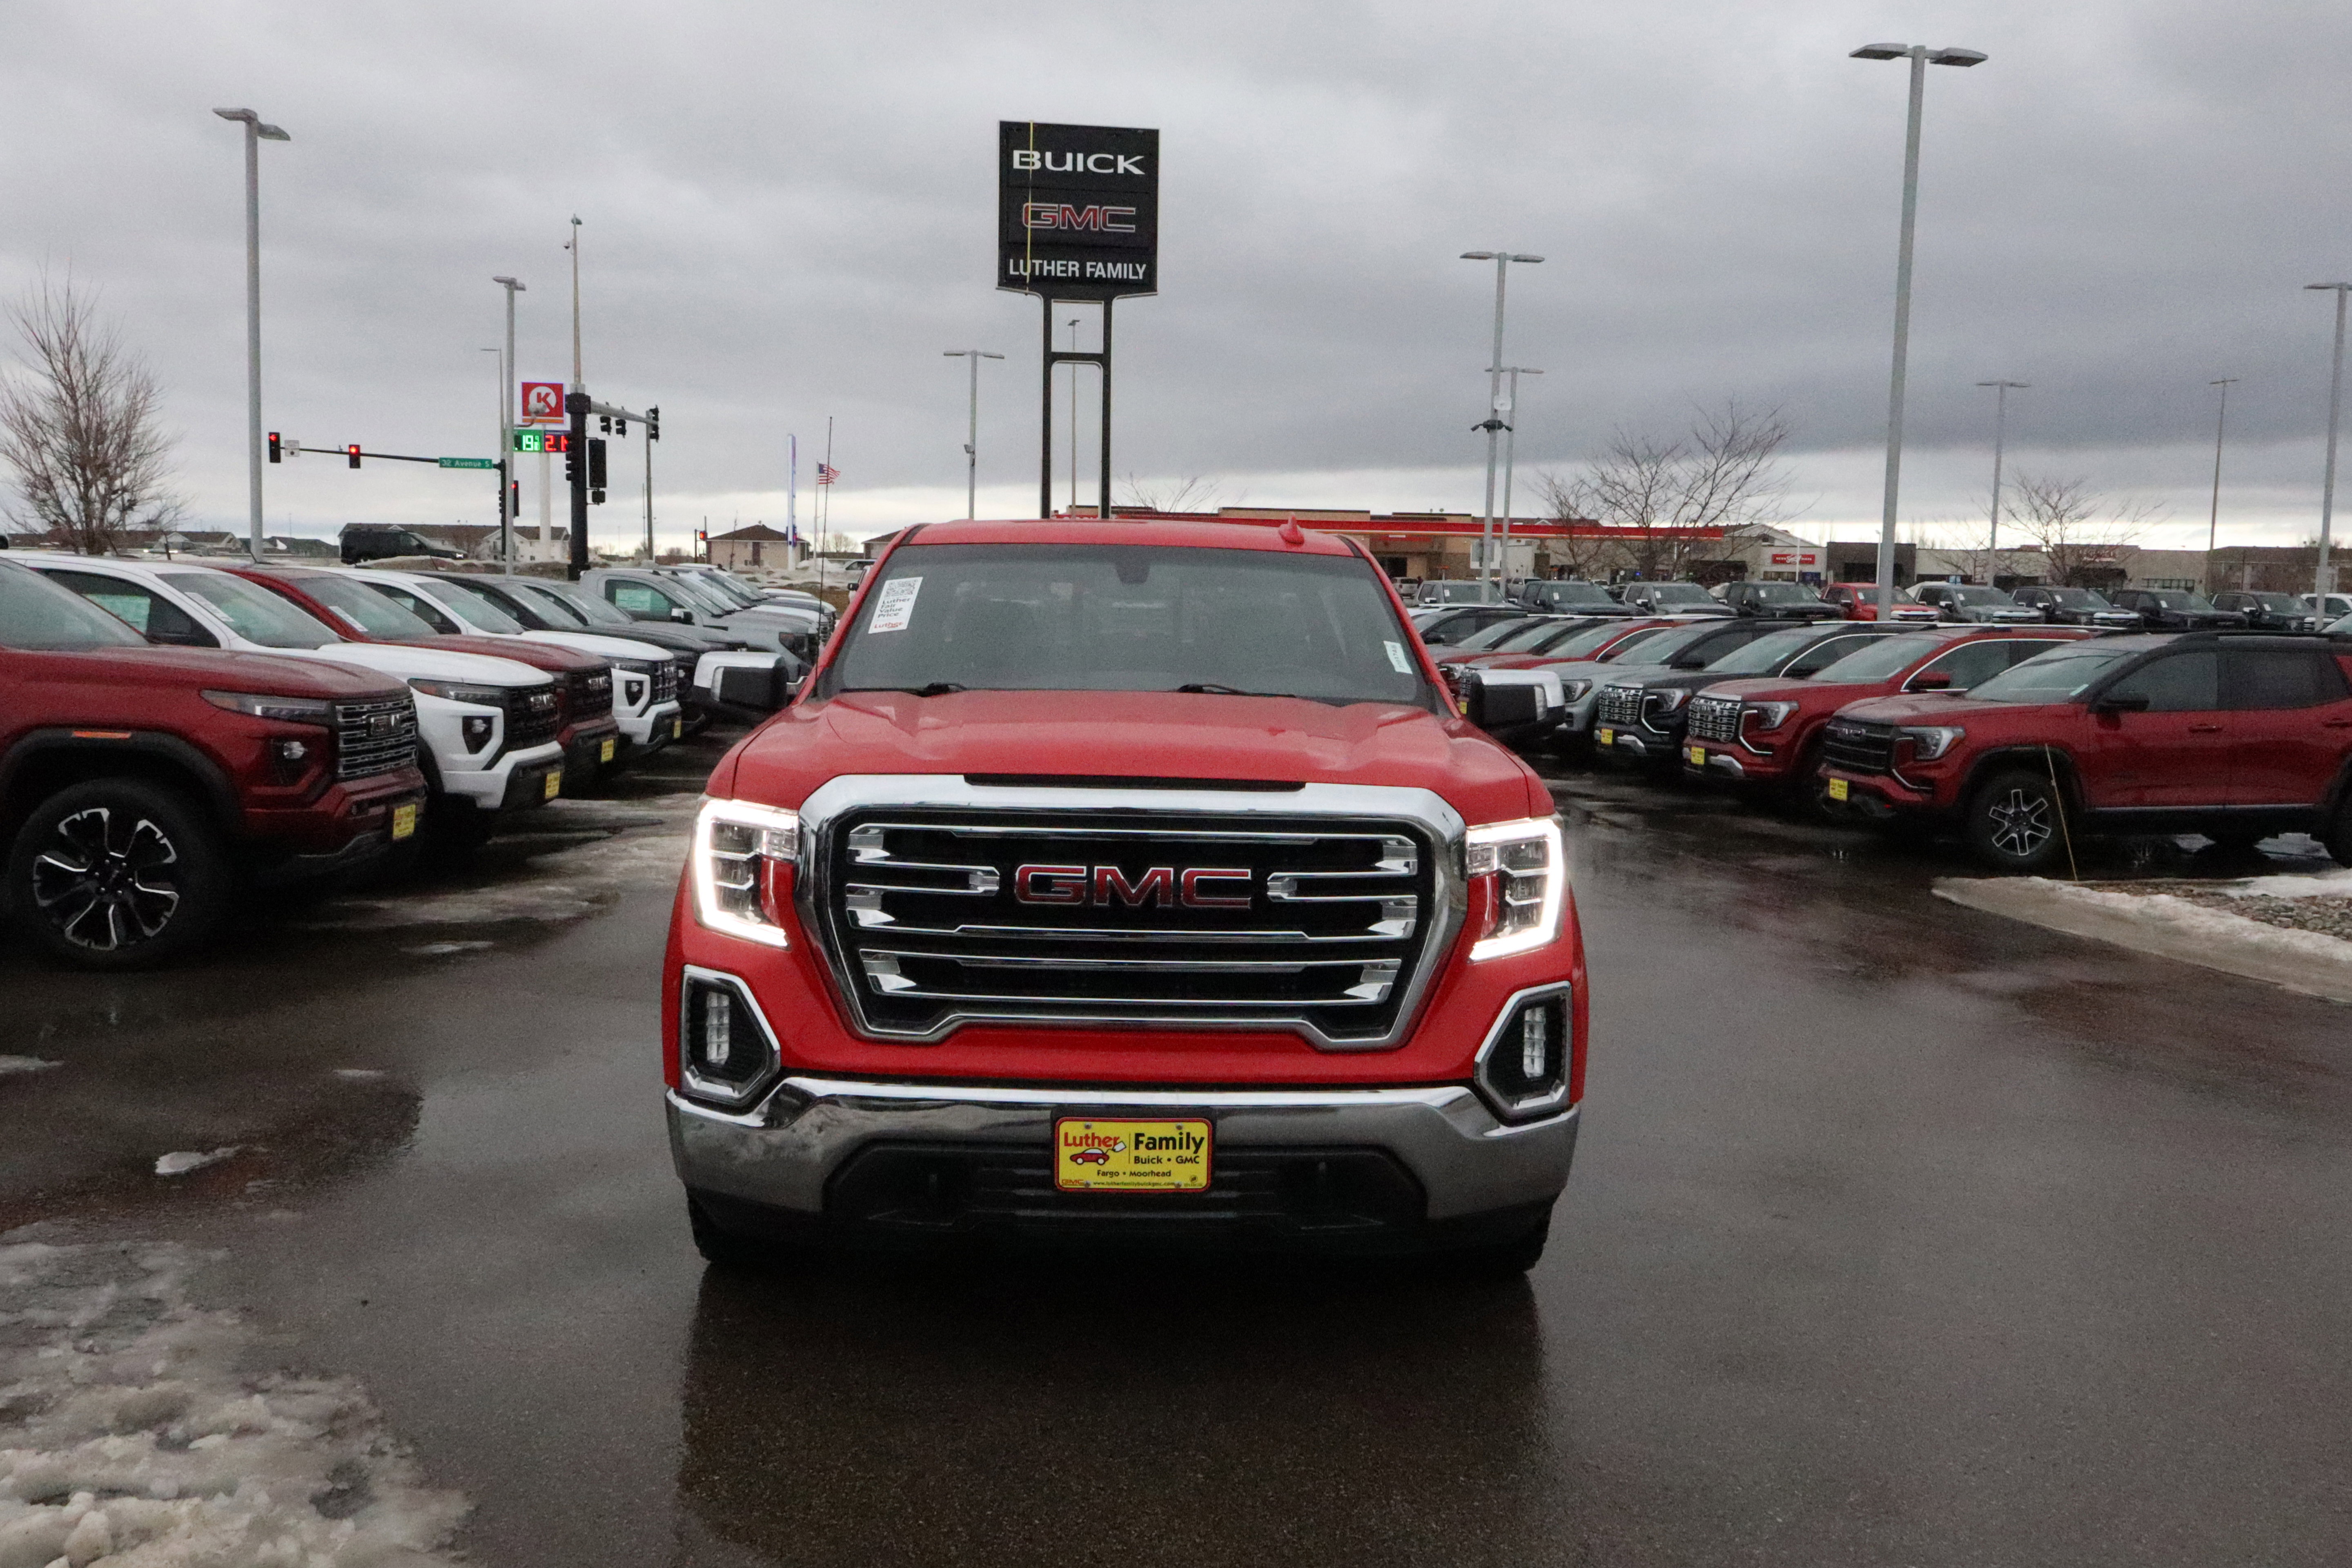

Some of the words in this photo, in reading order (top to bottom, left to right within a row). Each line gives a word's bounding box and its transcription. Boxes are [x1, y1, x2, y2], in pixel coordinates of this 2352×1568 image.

[1013, 149, 1145, 175] BUICK
[1022, 202, 1136, 233] GMC
[1009, 259, 1079, 277] LUTHER
[1086, 262, 1147, 280] FAMILY
[1015, 864, 1252, 909] GMC
[1064, 1132, 1120, 1147] Luther
[1134, 1132, 1205, 1154] Family
[1134, 1156, 1163, 1164] Buick
[1176, 1156, 1200, 1164] GMC
